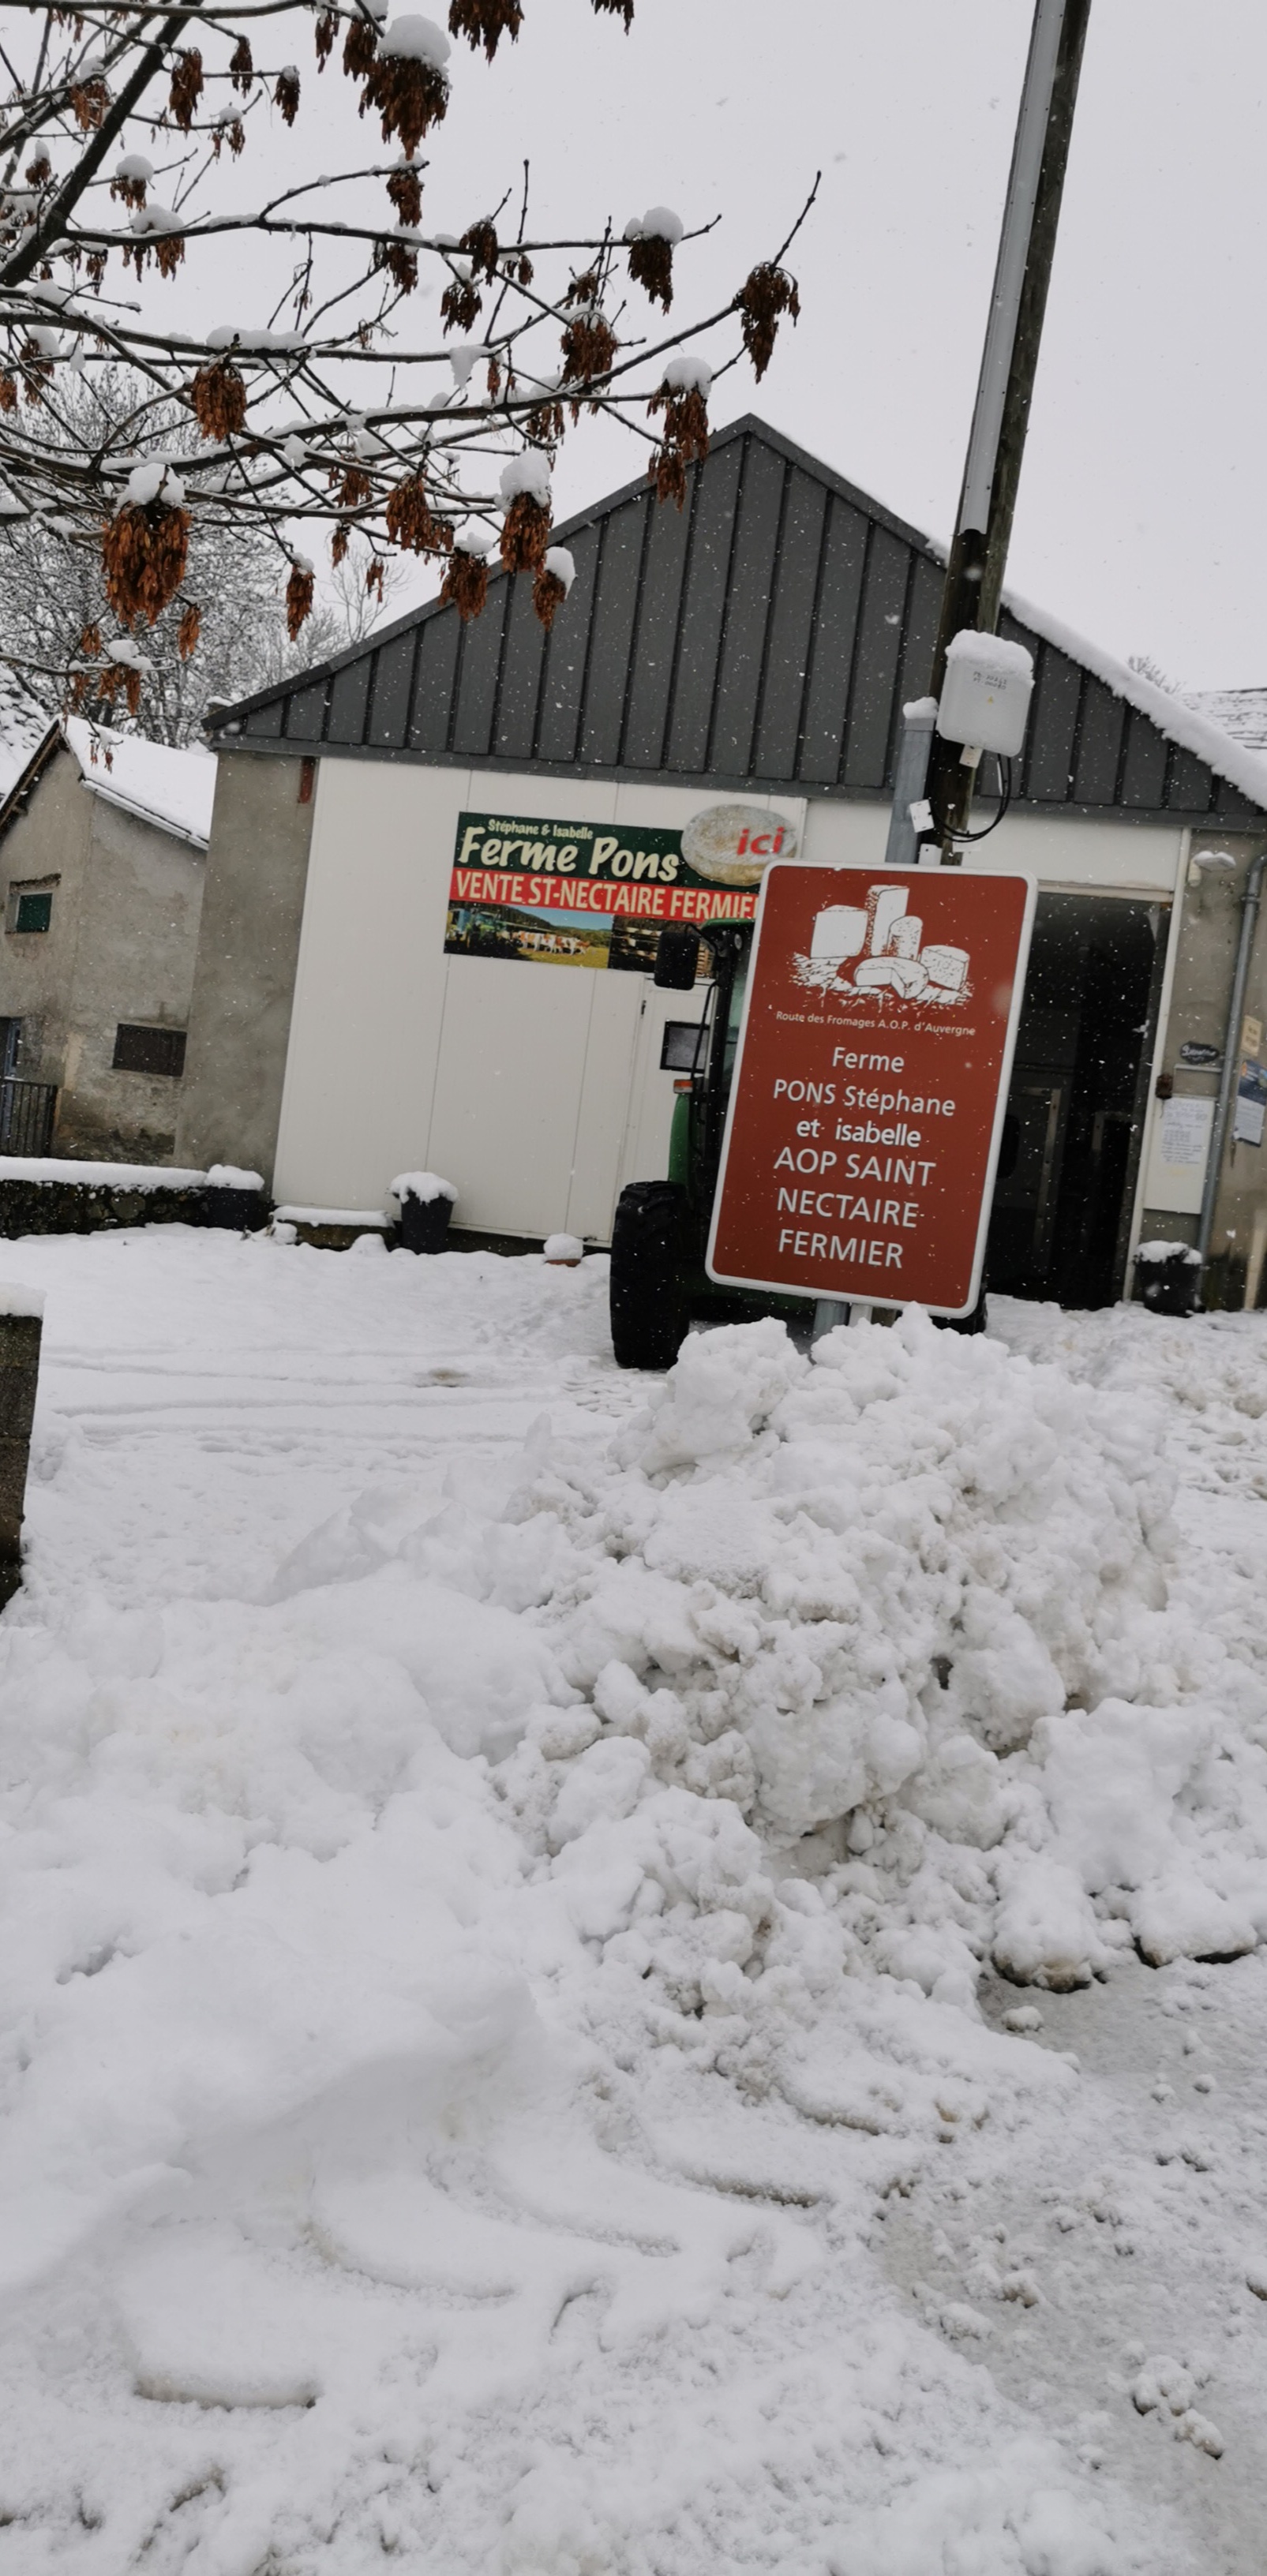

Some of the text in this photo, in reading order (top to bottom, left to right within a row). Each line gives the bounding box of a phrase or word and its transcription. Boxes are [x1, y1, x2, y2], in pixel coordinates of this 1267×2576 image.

[488, 818, 594, 840] Stéphane & Isabelle
[737, 826, 785, 856] ici
[458, 826, 680, 882] Ferme Pons
[456, 871, 760, 920] VENTE ST-NECTAIRE FERMIE
[776, 1011, 805, 1021] Route
[808, 1013, 824, 1024] des
[827, 1015, 875, 1029] Fromages
[878, 1020, 910, 1031] A.O.P.
[832, 1046, 905, 1073] Ferme
[773, 1079, 956, 1117] PONS Stéphane
[796, 1118, 922, 1148] et isabelle
[773, 1146, 937, 1187] AOP SAINT
[777, 1186, 920, 1228] NECTAIRE
[778, 1228, 904, 1269] FERMIER
